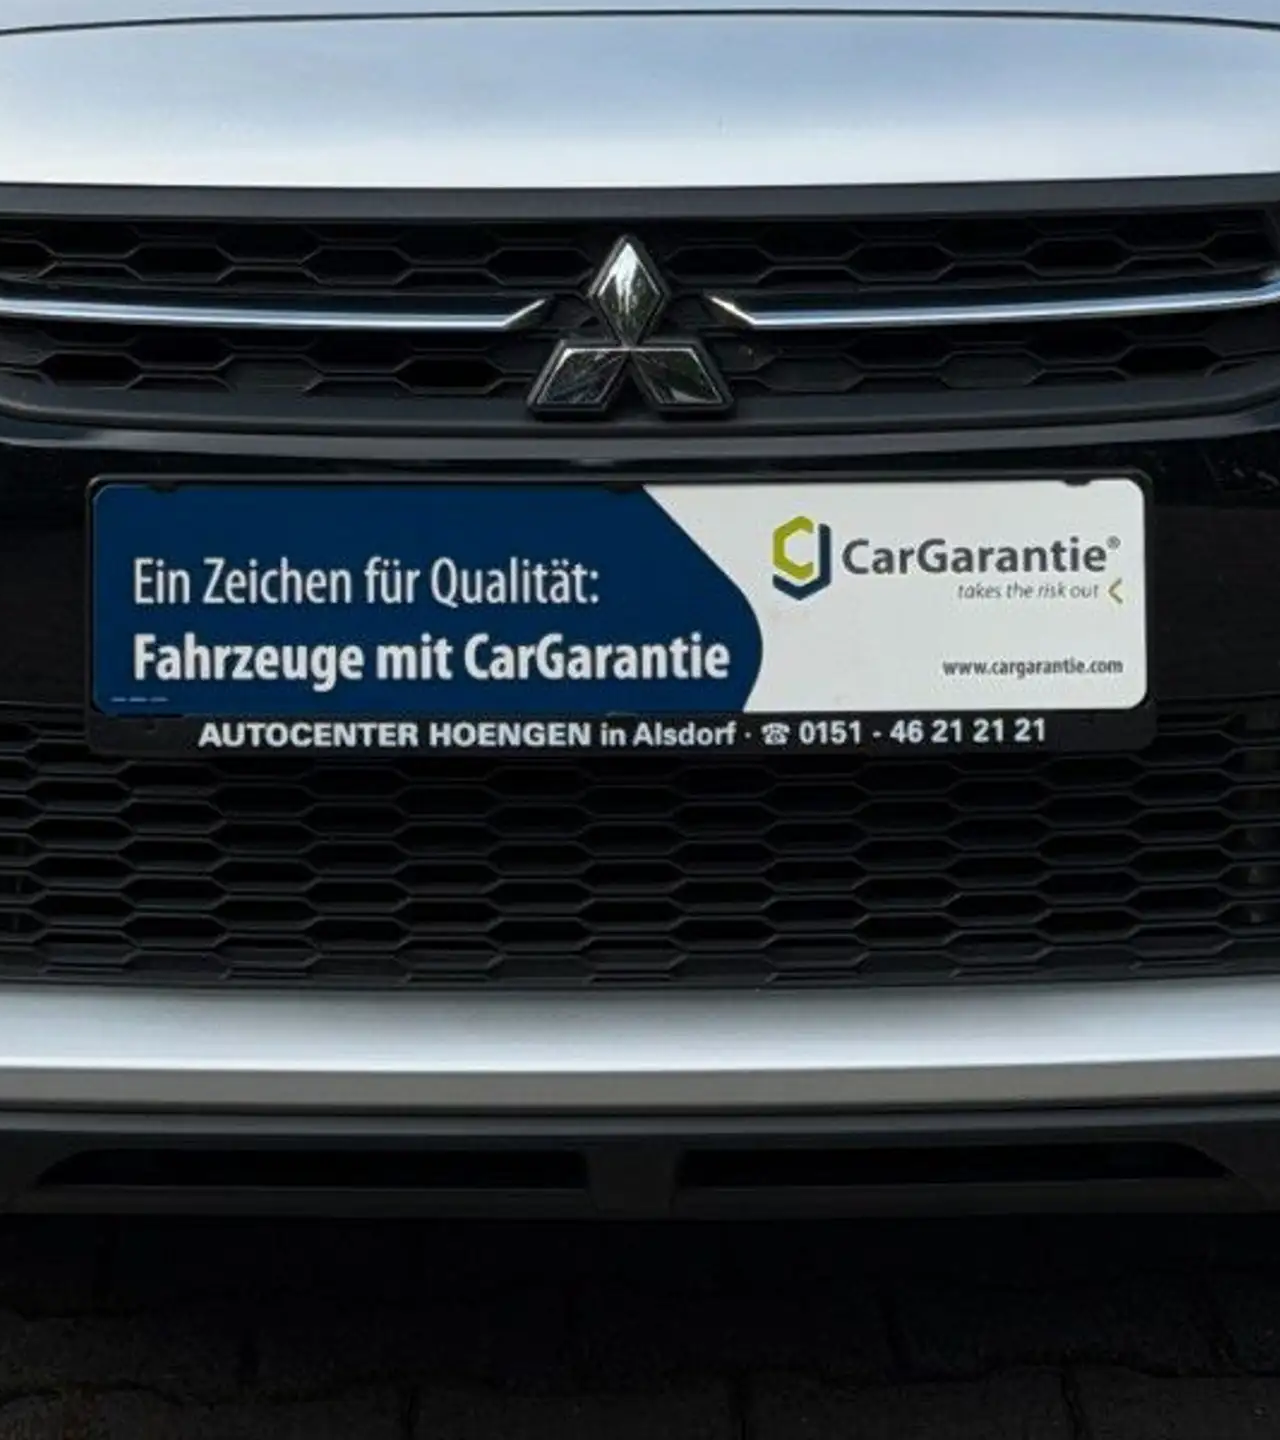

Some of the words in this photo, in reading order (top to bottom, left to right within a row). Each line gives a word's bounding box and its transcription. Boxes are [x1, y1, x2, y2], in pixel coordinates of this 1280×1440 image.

[134, 557, 190, 604] Ein
[202, 556, 352, 604] Zeichen
[363, 556, 421, 604] für
[431, 556, 599, 609] Qualität:
[958, 583, 1002, 599] takes
[1006, 581, 1033, 599] the
[1038, 581, 1066, 599] risk
[1070, 583, 1099, 599] out
[133, 632, 365, 693] Fahrzeuge
[376, 632, 454, 680] mit
[464, 631, 730, 680] CarGarantie
[942, 657, 1124, 679] www.cargarantie.com
[198, 722, 419, 747] AUTOCENTER
[429, 721, 591, 747] HOENGEN
[601, 721, 626, 746] in
[632, 720, 737, 746] Alsdorf
[799, 720, 861, 745] 0151
[889, 719, 924, 743] 46
[931, 718, 962, 743] 21
[973, 718, 1004, 743] 21
[1014, 717, 1045, 742] 21
